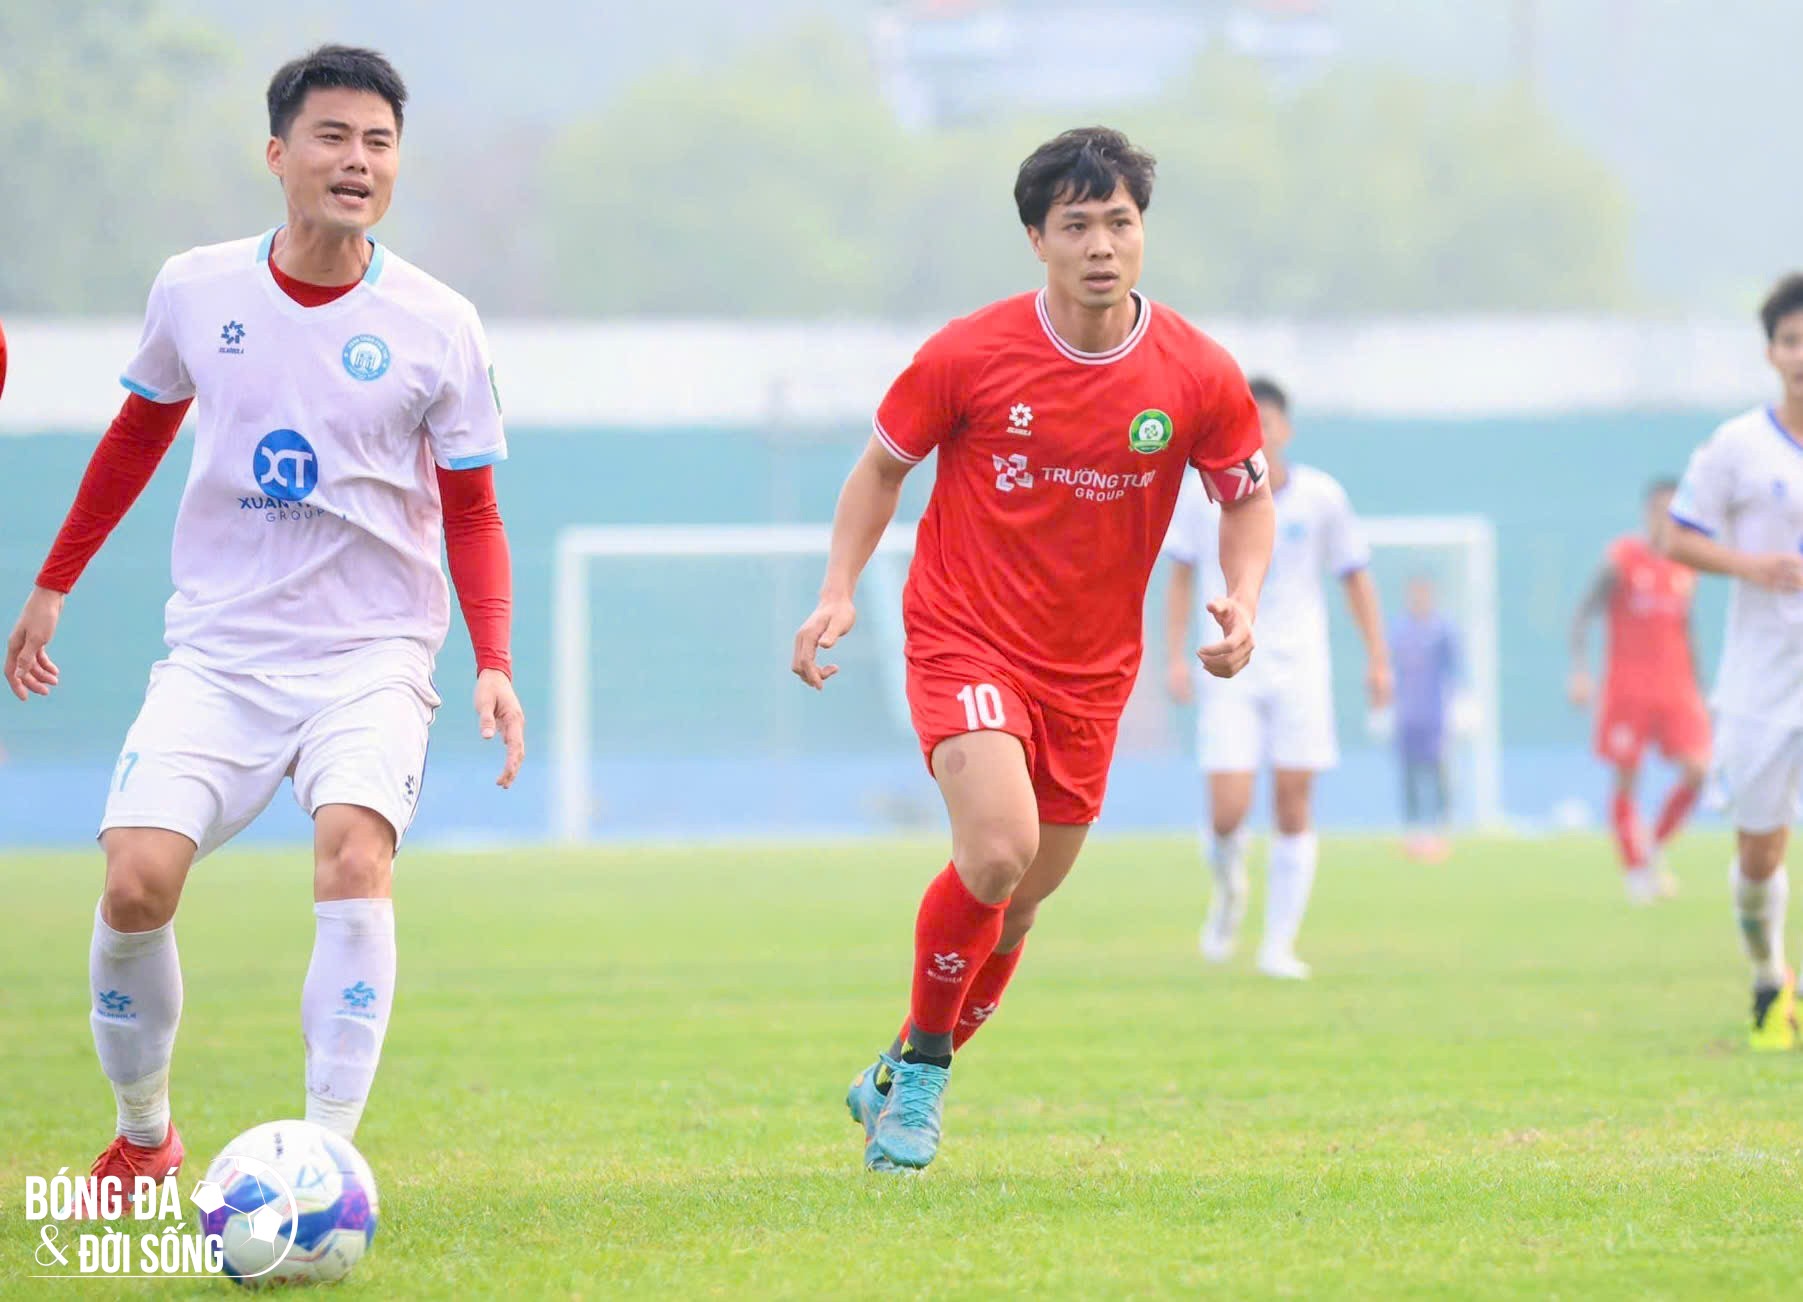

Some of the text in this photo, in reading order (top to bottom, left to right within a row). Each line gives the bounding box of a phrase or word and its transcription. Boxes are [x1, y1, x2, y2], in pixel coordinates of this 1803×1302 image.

[260, 446, 313, 489] XT
[1075, 487, 1125, 502] GROUP
[265, 509, 325, 522] GROUP
[956, 683, 1006, 731] 10
